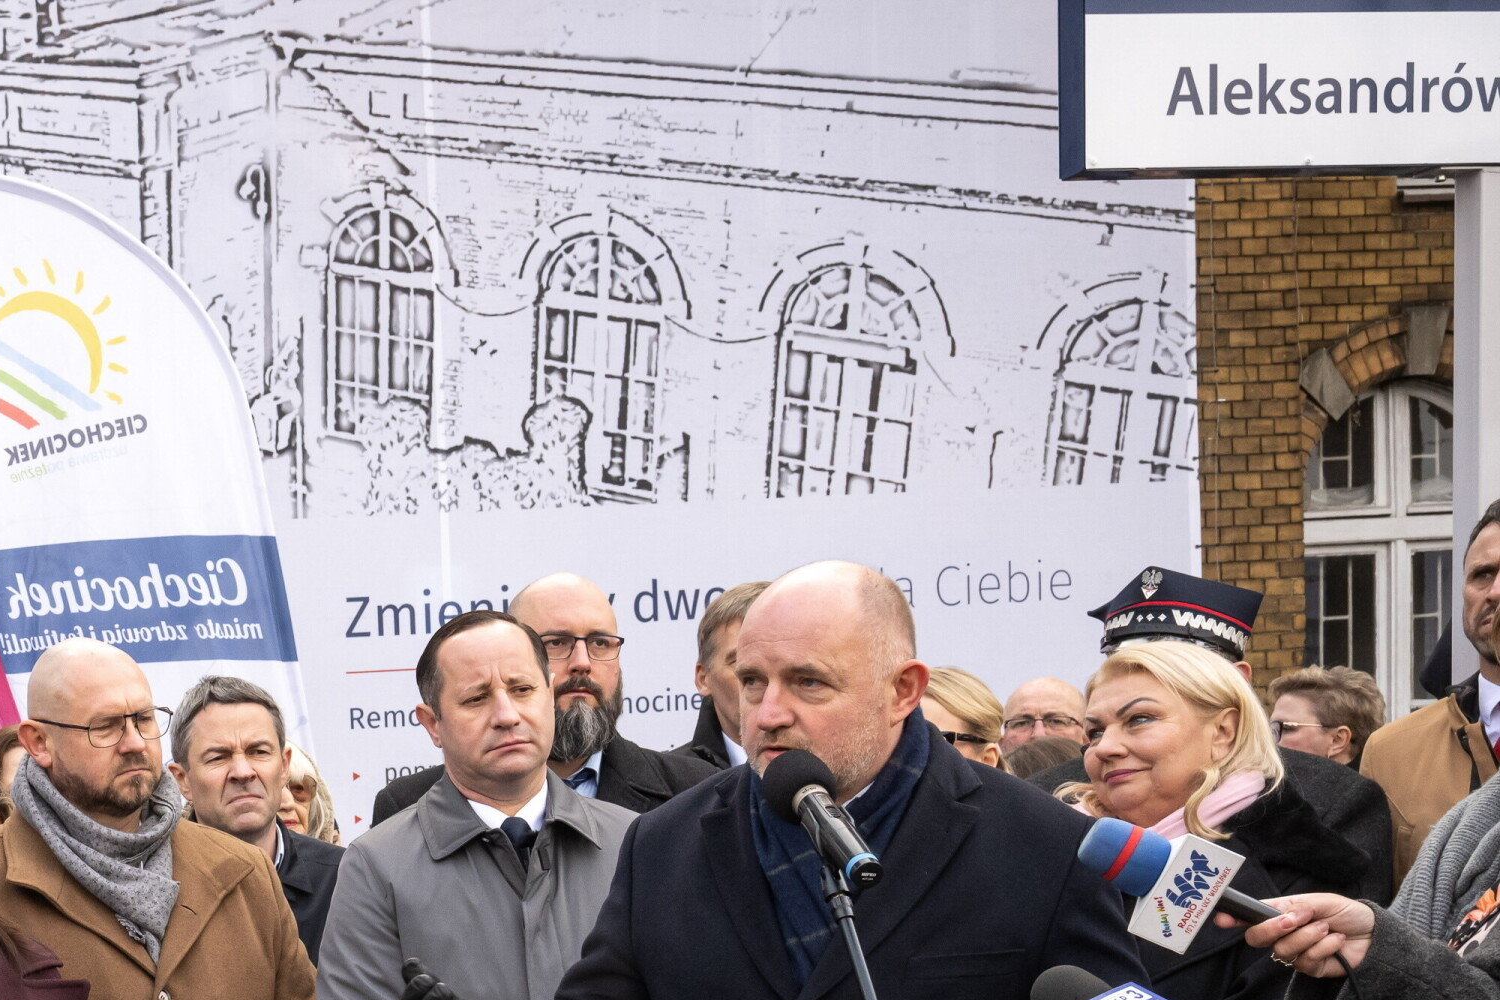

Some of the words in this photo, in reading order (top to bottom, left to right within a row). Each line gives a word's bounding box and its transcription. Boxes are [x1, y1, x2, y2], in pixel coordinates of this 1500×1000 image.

[1166, 61, 1500, 116] Aleksandrów
[936, 559, 1072, 607] Ciebie
[1177, 903, 1198, 929] RADIO
